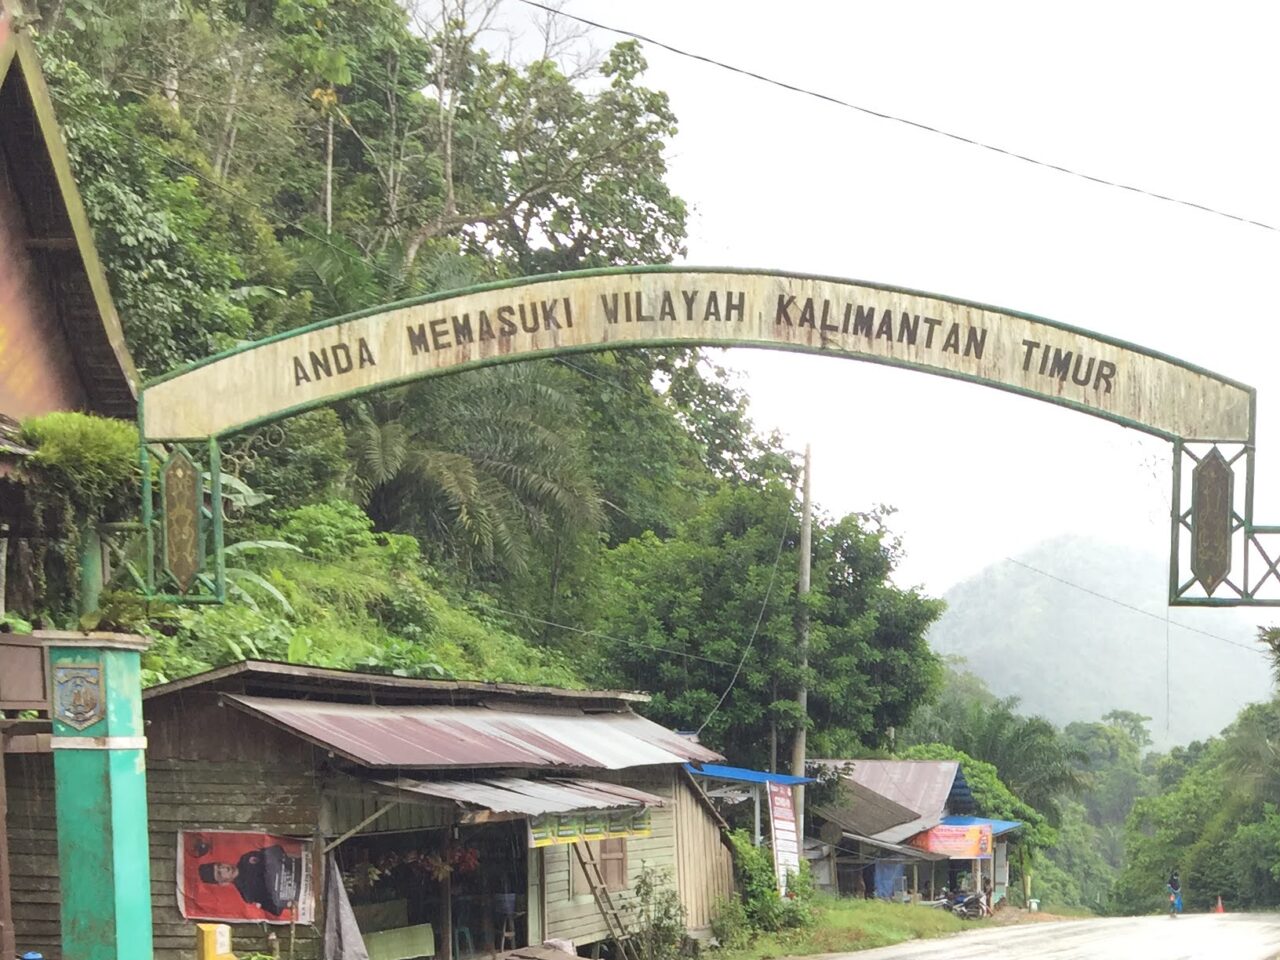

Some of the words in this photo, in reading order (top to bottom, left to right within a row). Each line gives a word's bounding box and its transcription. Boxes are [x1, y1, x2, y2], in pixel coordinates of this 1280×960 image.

[292, 336, 377, 387] ANDA
[404, 296, 575, 357] MEMASUKI
[774, 293, 987, 360] KALIMANTAN
[1020, 338, 1118, 394] TIMUR
